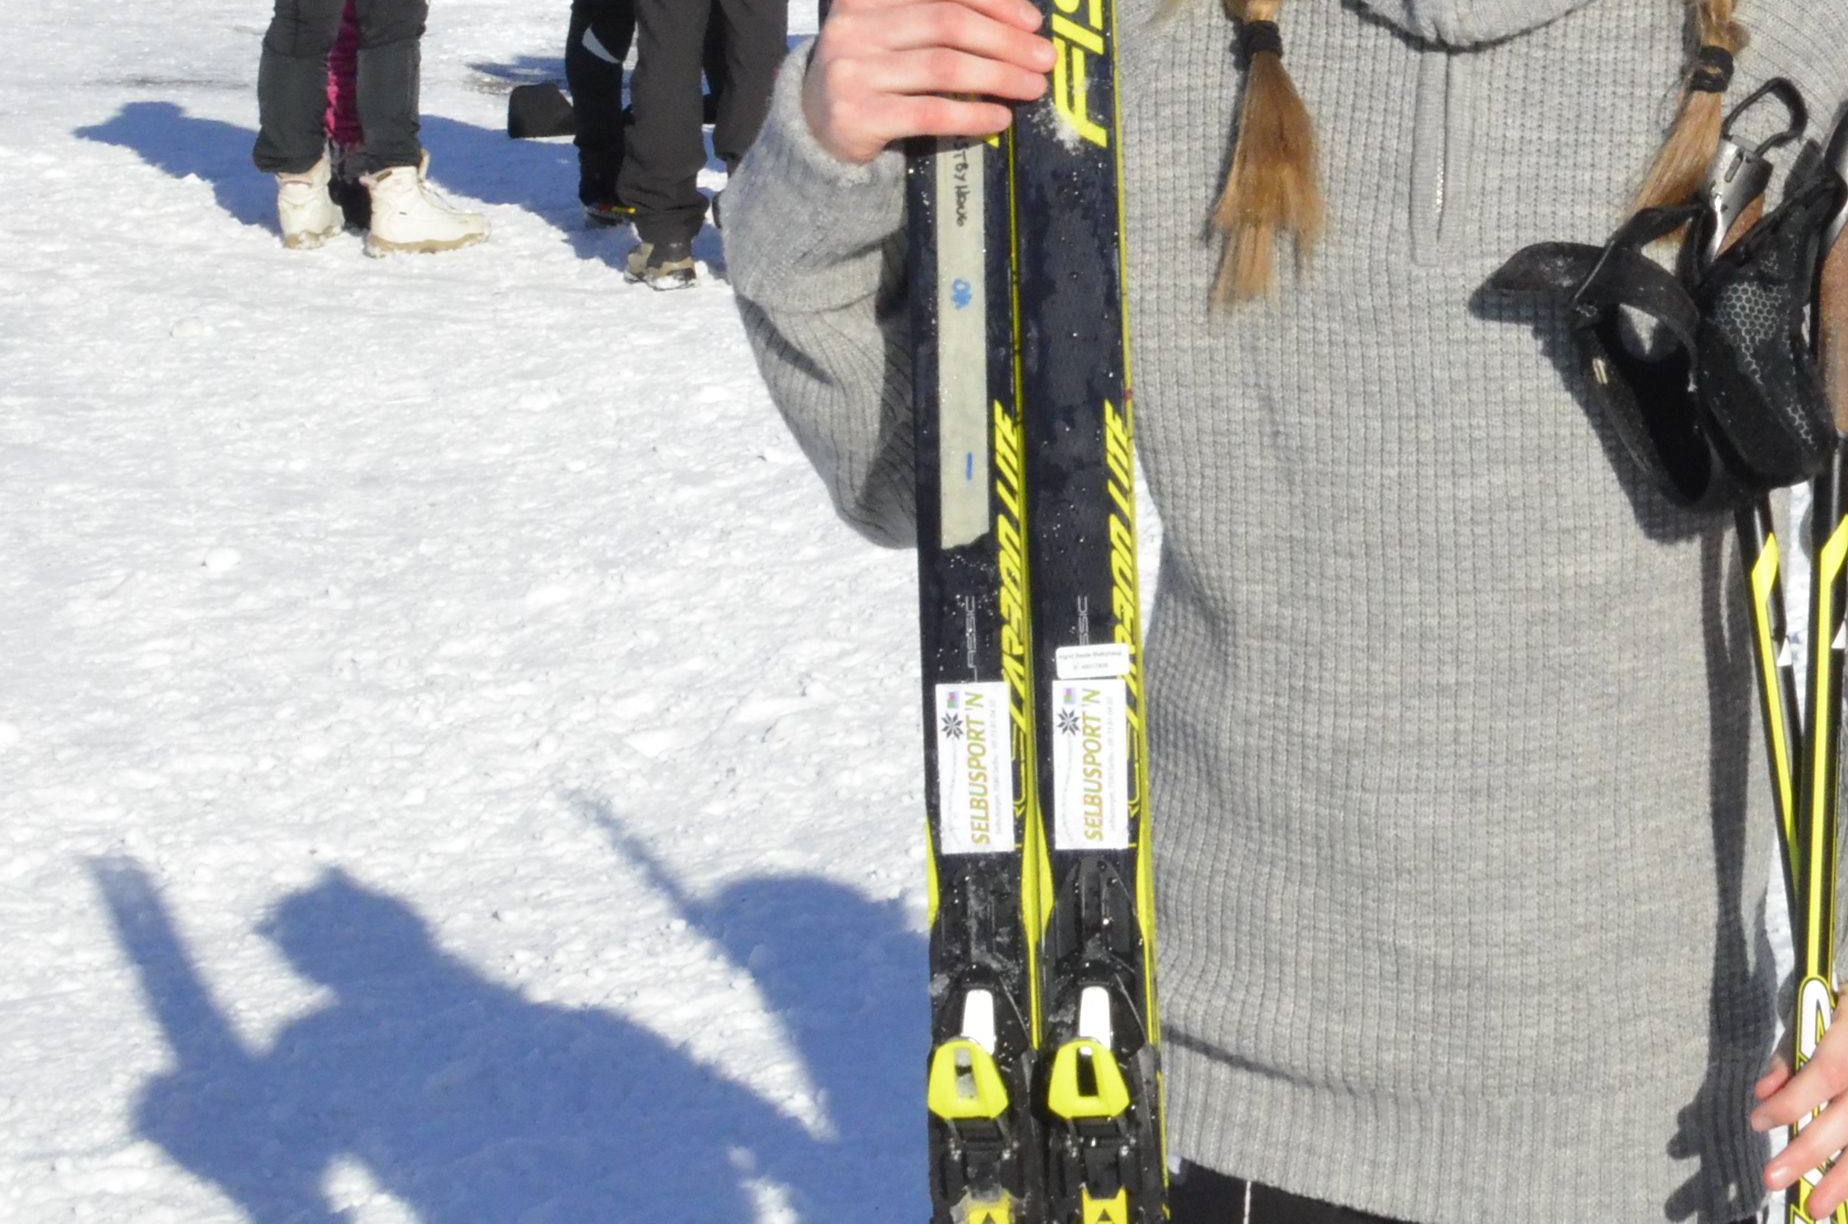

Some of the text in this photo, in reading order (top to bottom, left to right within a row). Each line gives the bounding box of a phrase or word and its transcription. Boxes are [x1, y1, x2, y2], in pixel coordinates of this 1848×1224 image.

[994, 400, 1020, 514] LITE
[1105, 399, 1130, 514] LITE
[966, 595, 978, 682] LASSIC
[1077, 595, 1089, 645] SSIC
[966, 715, 990, 845] SELBUSPORT
[1082, 711, 1103, 842] SELBUSPORT
